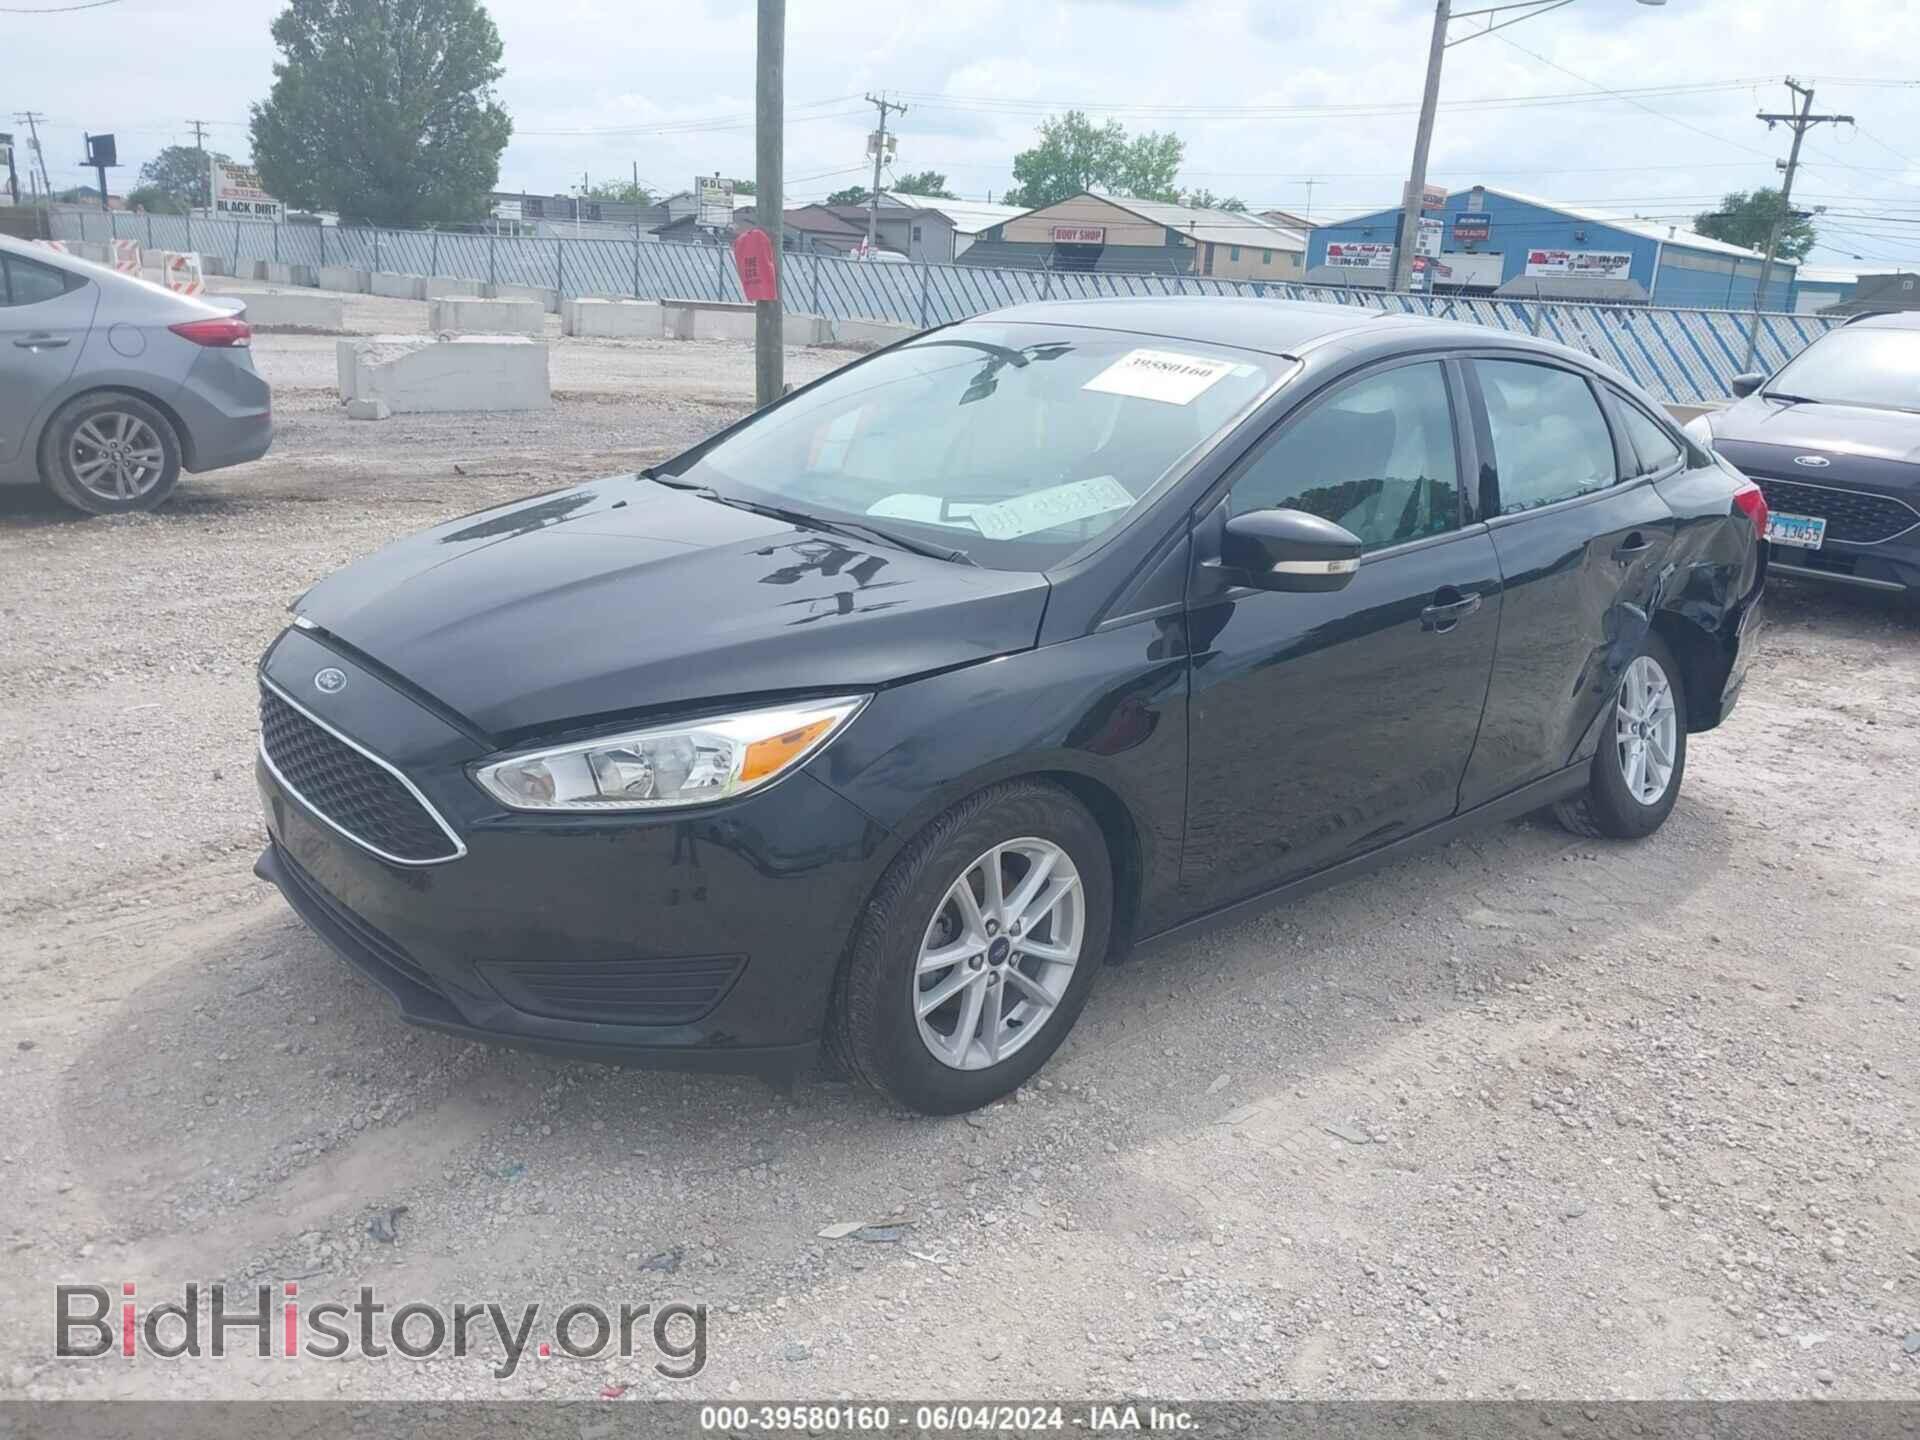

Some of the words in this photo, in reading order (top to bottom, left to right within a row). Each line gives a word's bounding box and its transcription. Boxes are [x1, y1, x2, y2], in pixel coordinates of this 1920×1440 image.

[217, 199, 251, 213] BLACK
[255, 202, 277, 215] DIRT
[1055, 229, 1077, 240] BODY
[1079, 229, 1101, 241] SHOP
